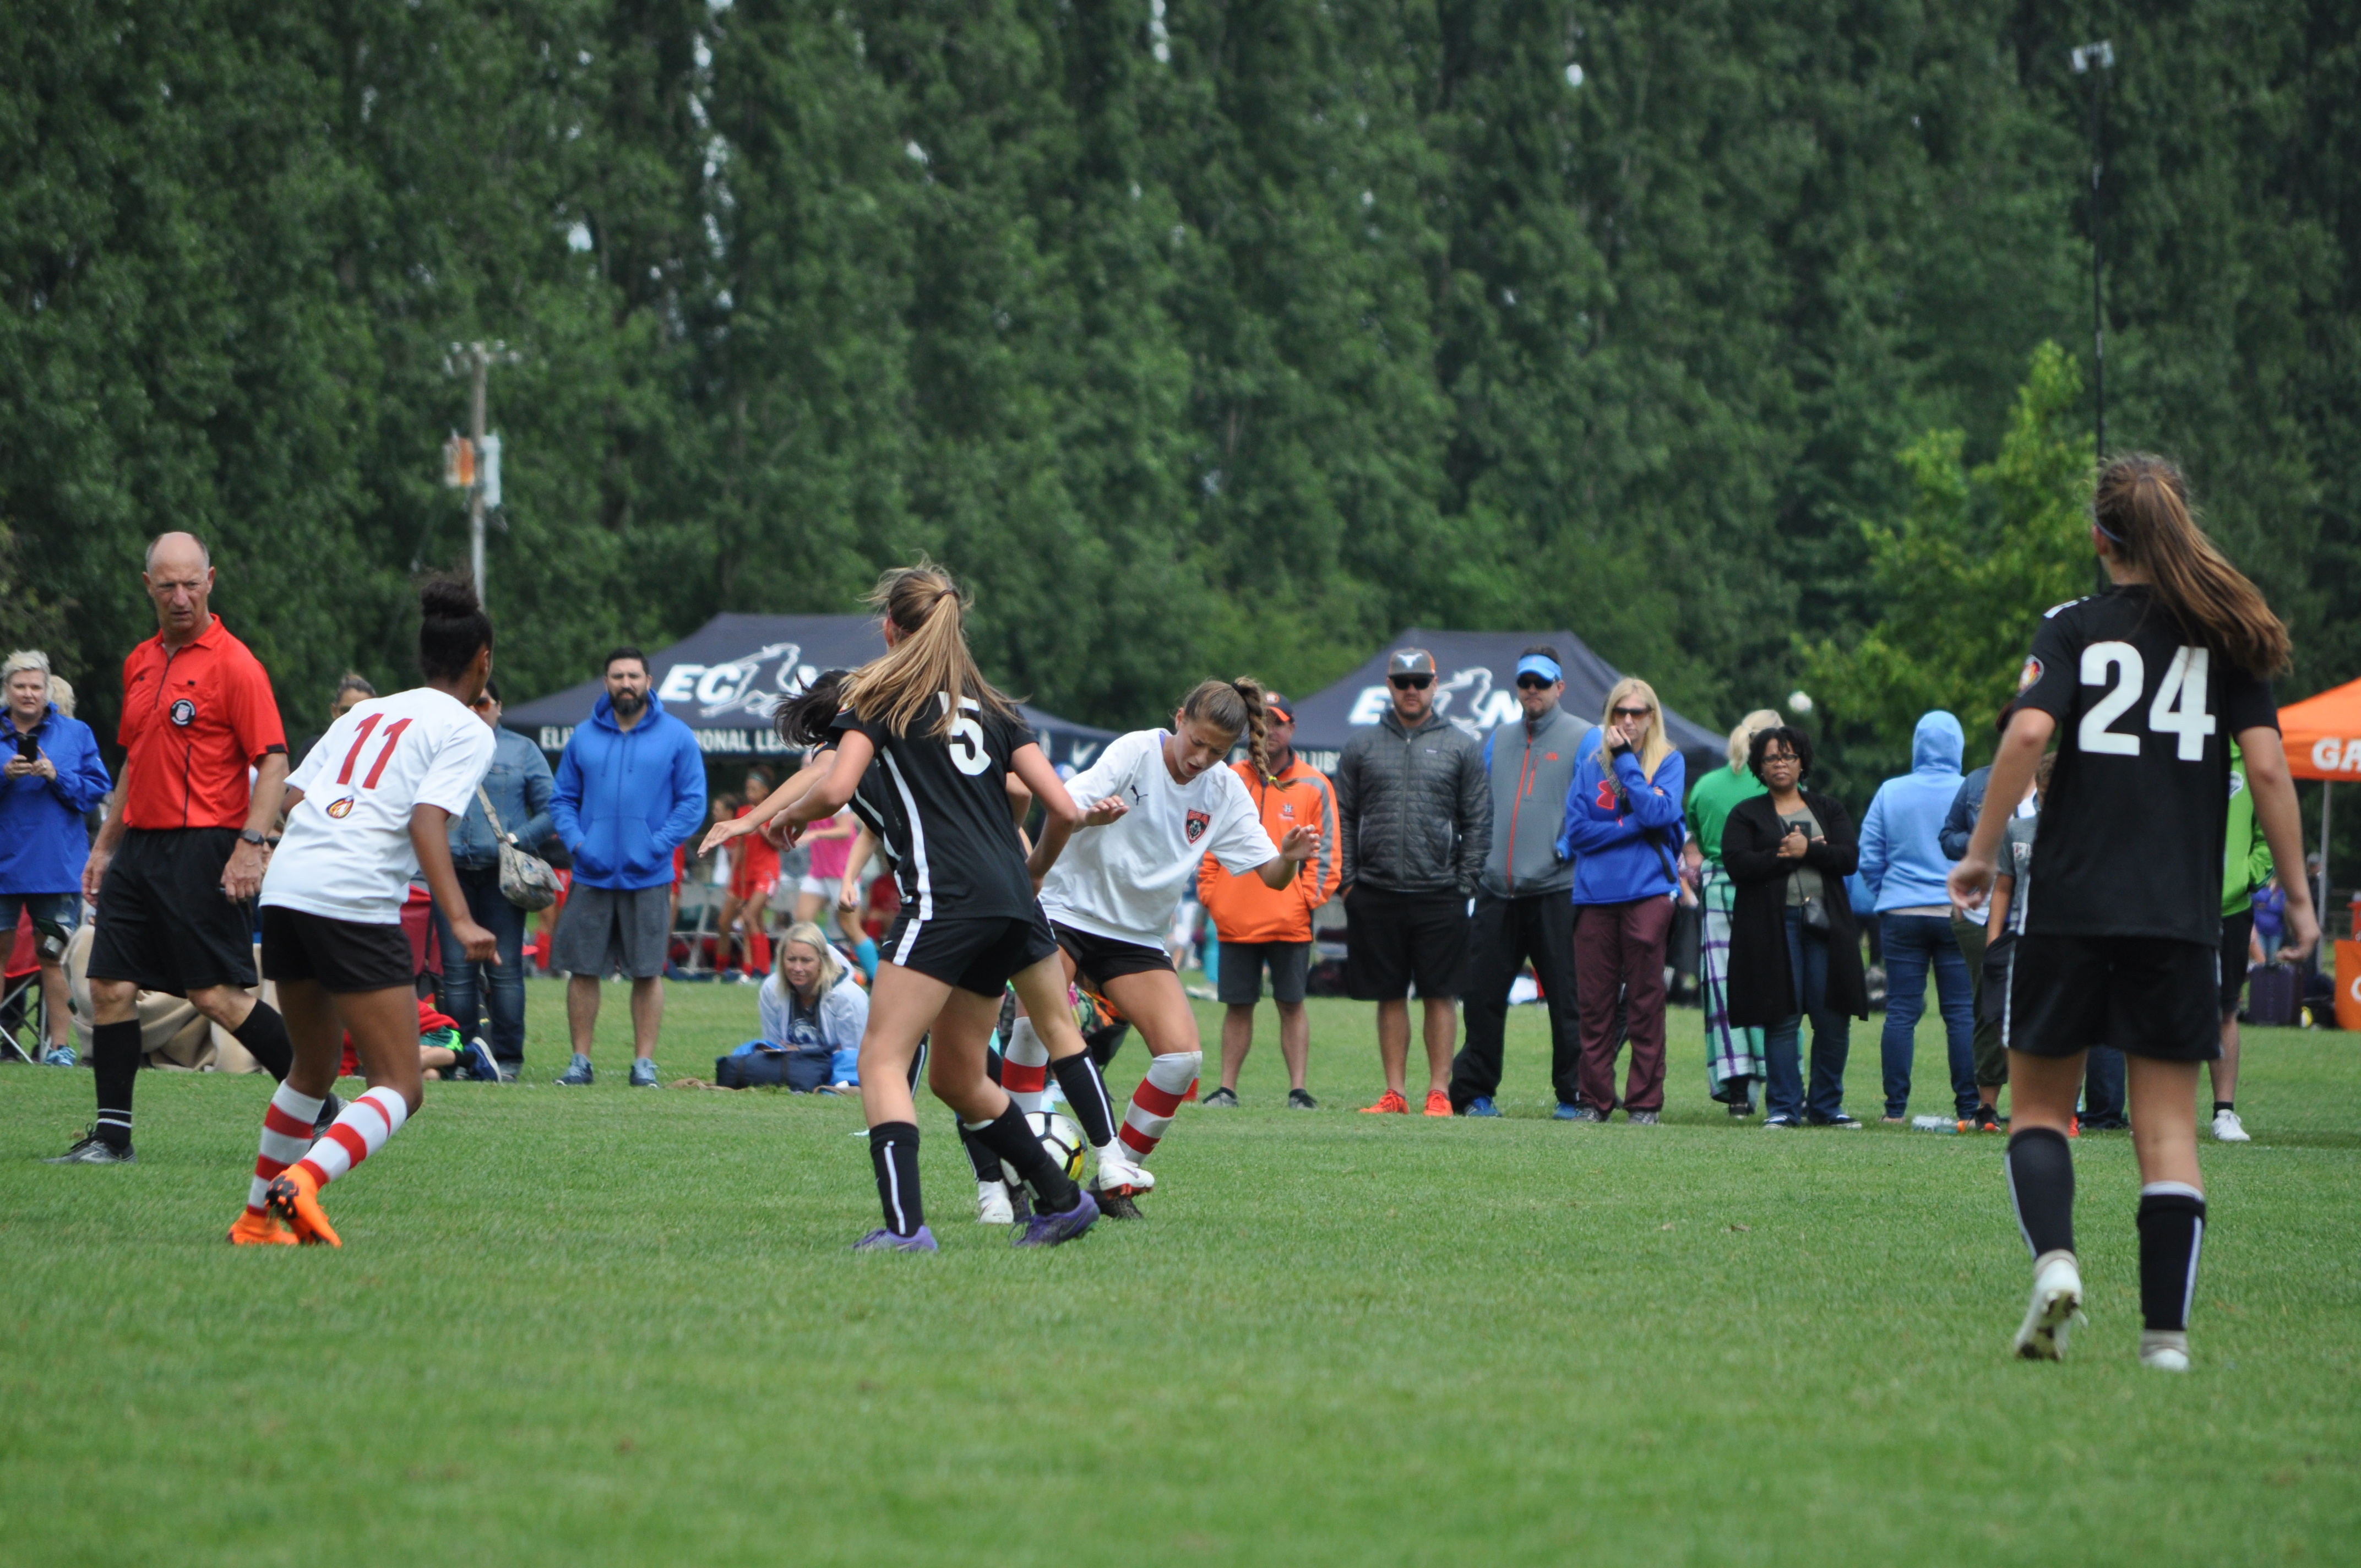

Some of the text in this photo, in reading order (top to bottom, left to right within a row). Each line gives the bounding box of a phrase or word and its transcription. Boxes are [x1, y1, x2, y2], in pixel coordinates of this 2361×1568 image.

[938, 691, 991, 775] 5
[2079, 641, 2216, 761] 24
[336, 712, 414, 790] 11
[693, 729, 751, 752] IONAL
[2311, 737, 2361, 772] GA
